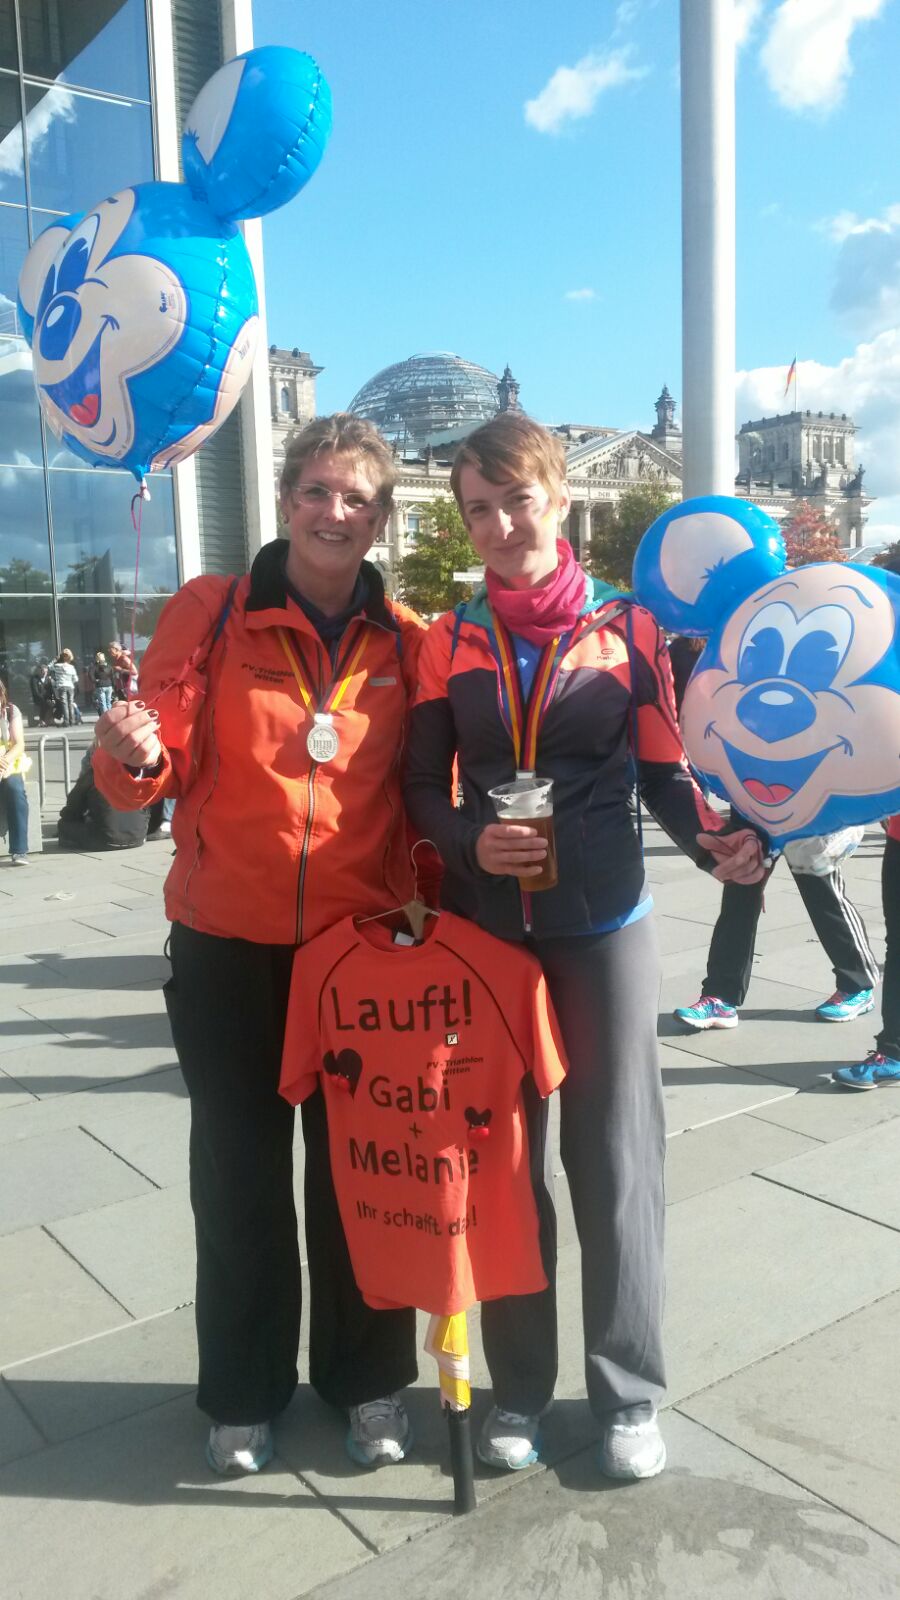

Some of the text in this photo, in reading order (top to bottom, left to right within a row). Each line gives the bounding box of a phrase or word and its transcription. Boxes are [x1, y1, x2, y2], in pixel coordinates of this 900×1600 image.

[254, 673, 284, 684] Witten
[331, 979, 472, 1032] Lauft!
[442, 1067, 470, 1077] Witten
[369, 1075, 451, 1113] Gabi
[349, 1137, 480, 1185] Melanie
[356, 1200, 377, 1220] Ihr
[383, 1208, 442, 1236] schafft
